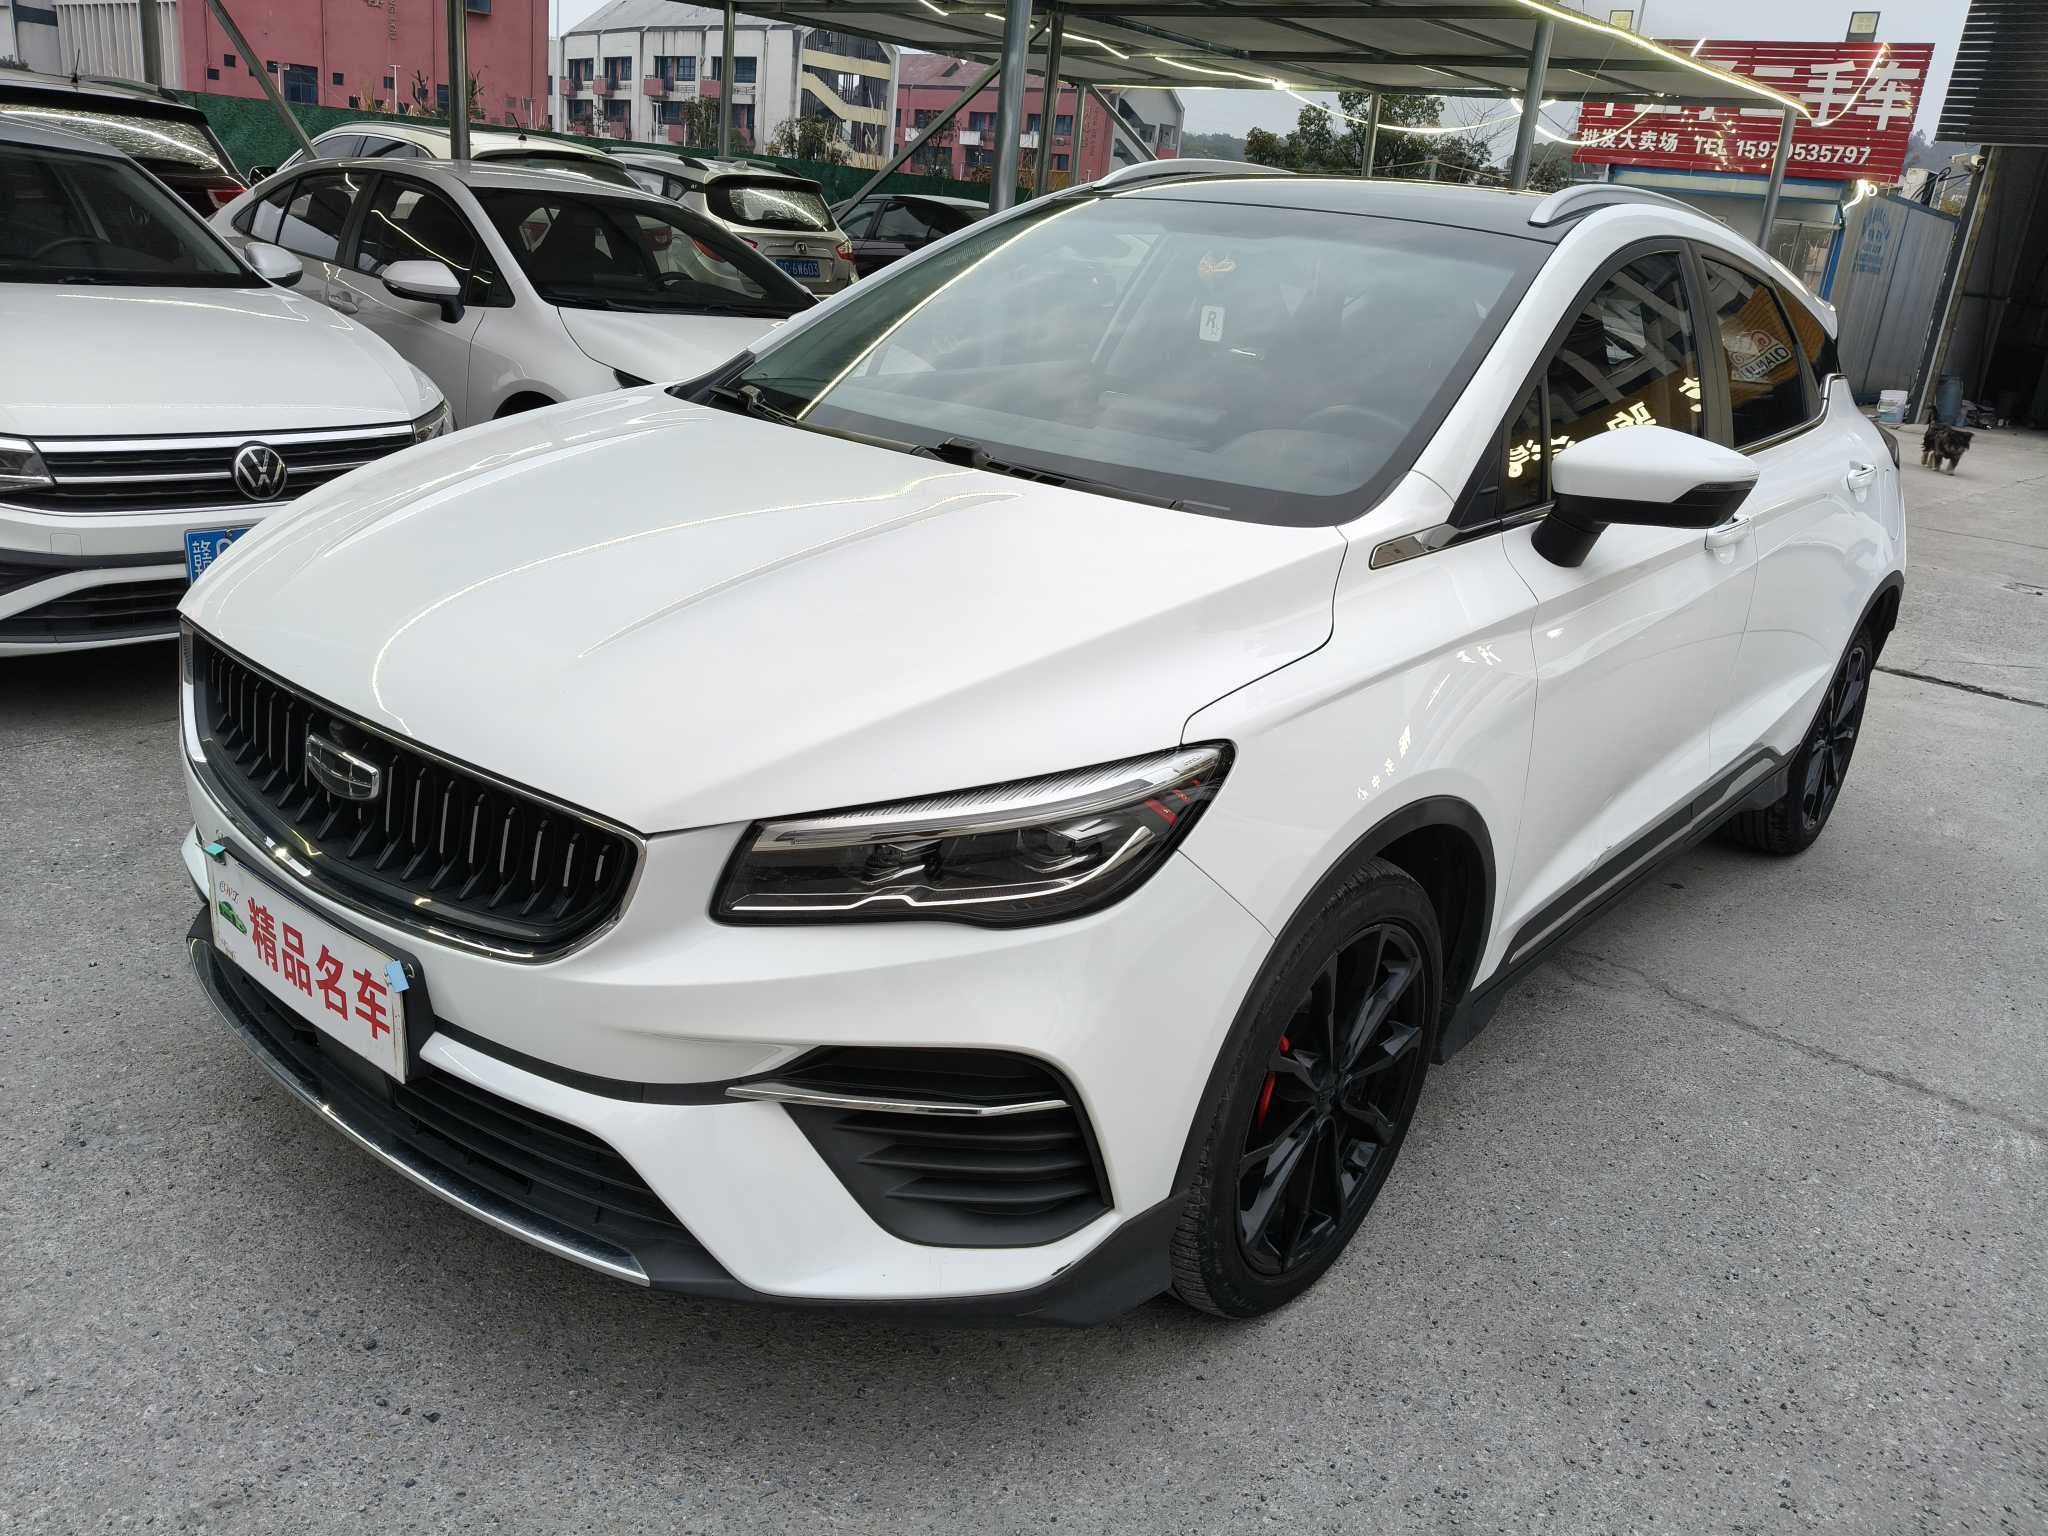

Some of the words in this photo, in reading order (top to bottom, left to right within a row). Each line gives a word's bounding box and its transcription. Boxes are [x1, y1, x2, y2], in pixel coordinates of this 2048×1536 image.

[1581, 128, 1679, 153] 批发大卖场
[248, 896, 391, 1040] 精品名车
